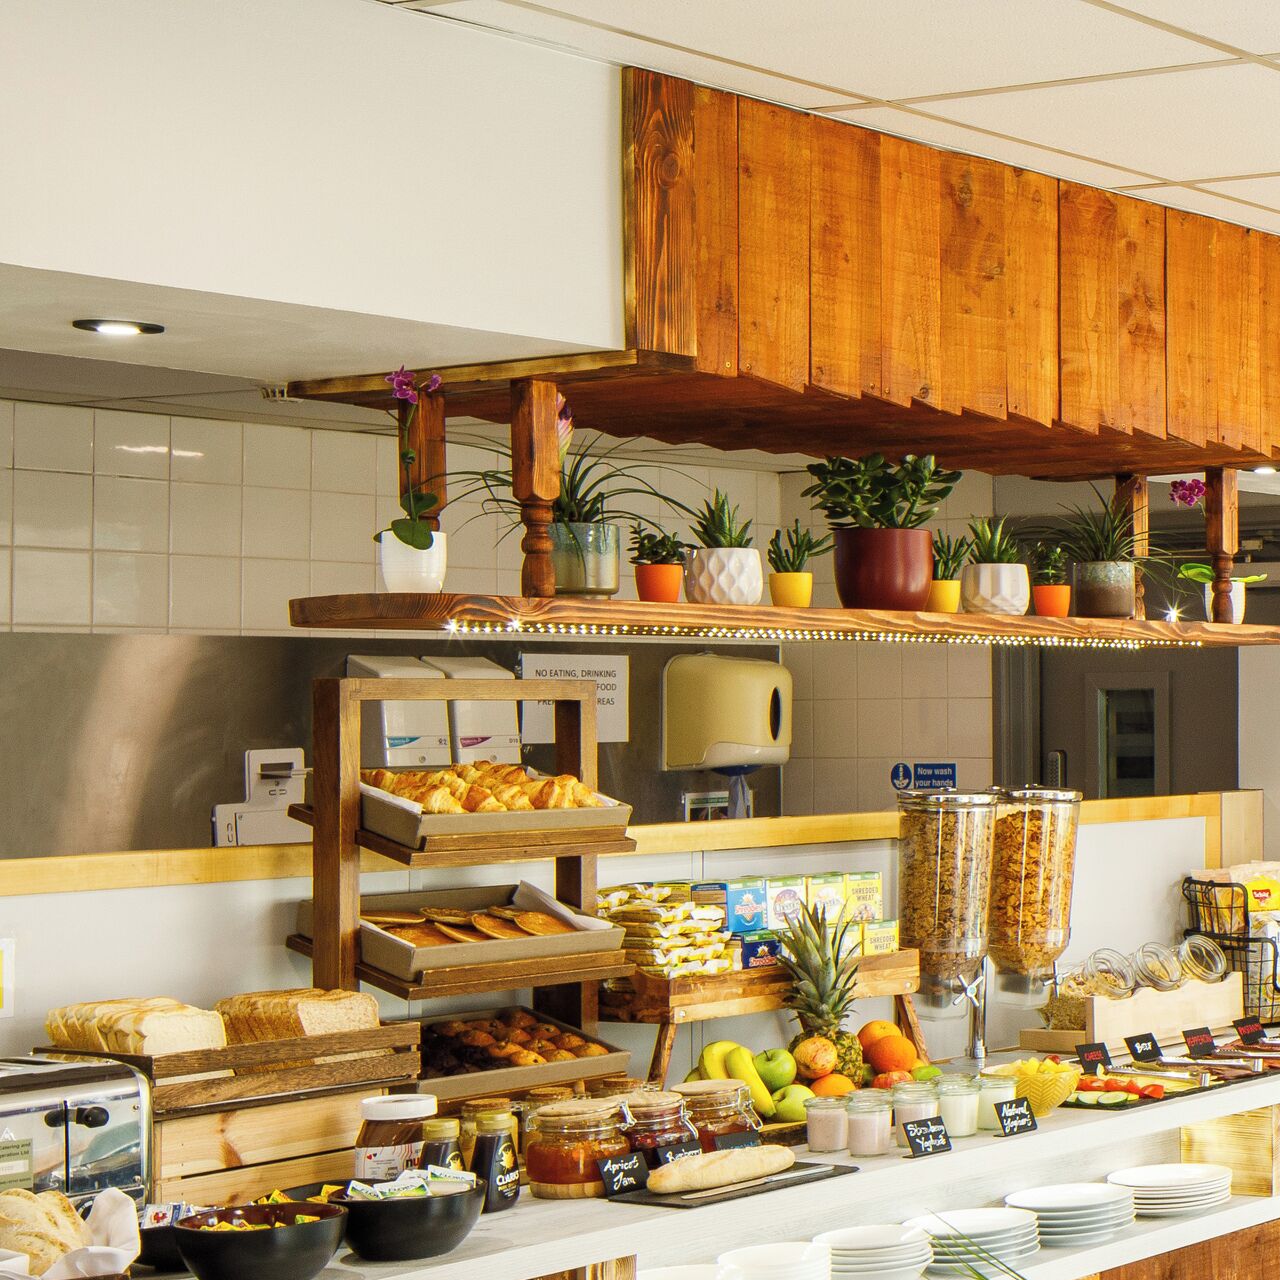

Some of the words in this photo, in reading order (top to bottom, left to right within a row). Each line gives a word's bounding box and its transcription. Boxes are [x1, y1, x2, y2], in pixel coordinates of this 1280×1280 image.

[535, 669, 547, 677] NO
[549, 669, 579, 679] EATING,
[581, 669, 617, 678] DRINKING
[596, 683, 617, 691] FOOD
[917, 767, 933, 775] Now
[934, 767, 953, 775] wash
[932, 778, 954, 787] hands
[1002, 1101, 1030, 1117] Natural
[603, 1155, 639, 1175] Apricot
[612, 1172, 637, 1191] Jam
